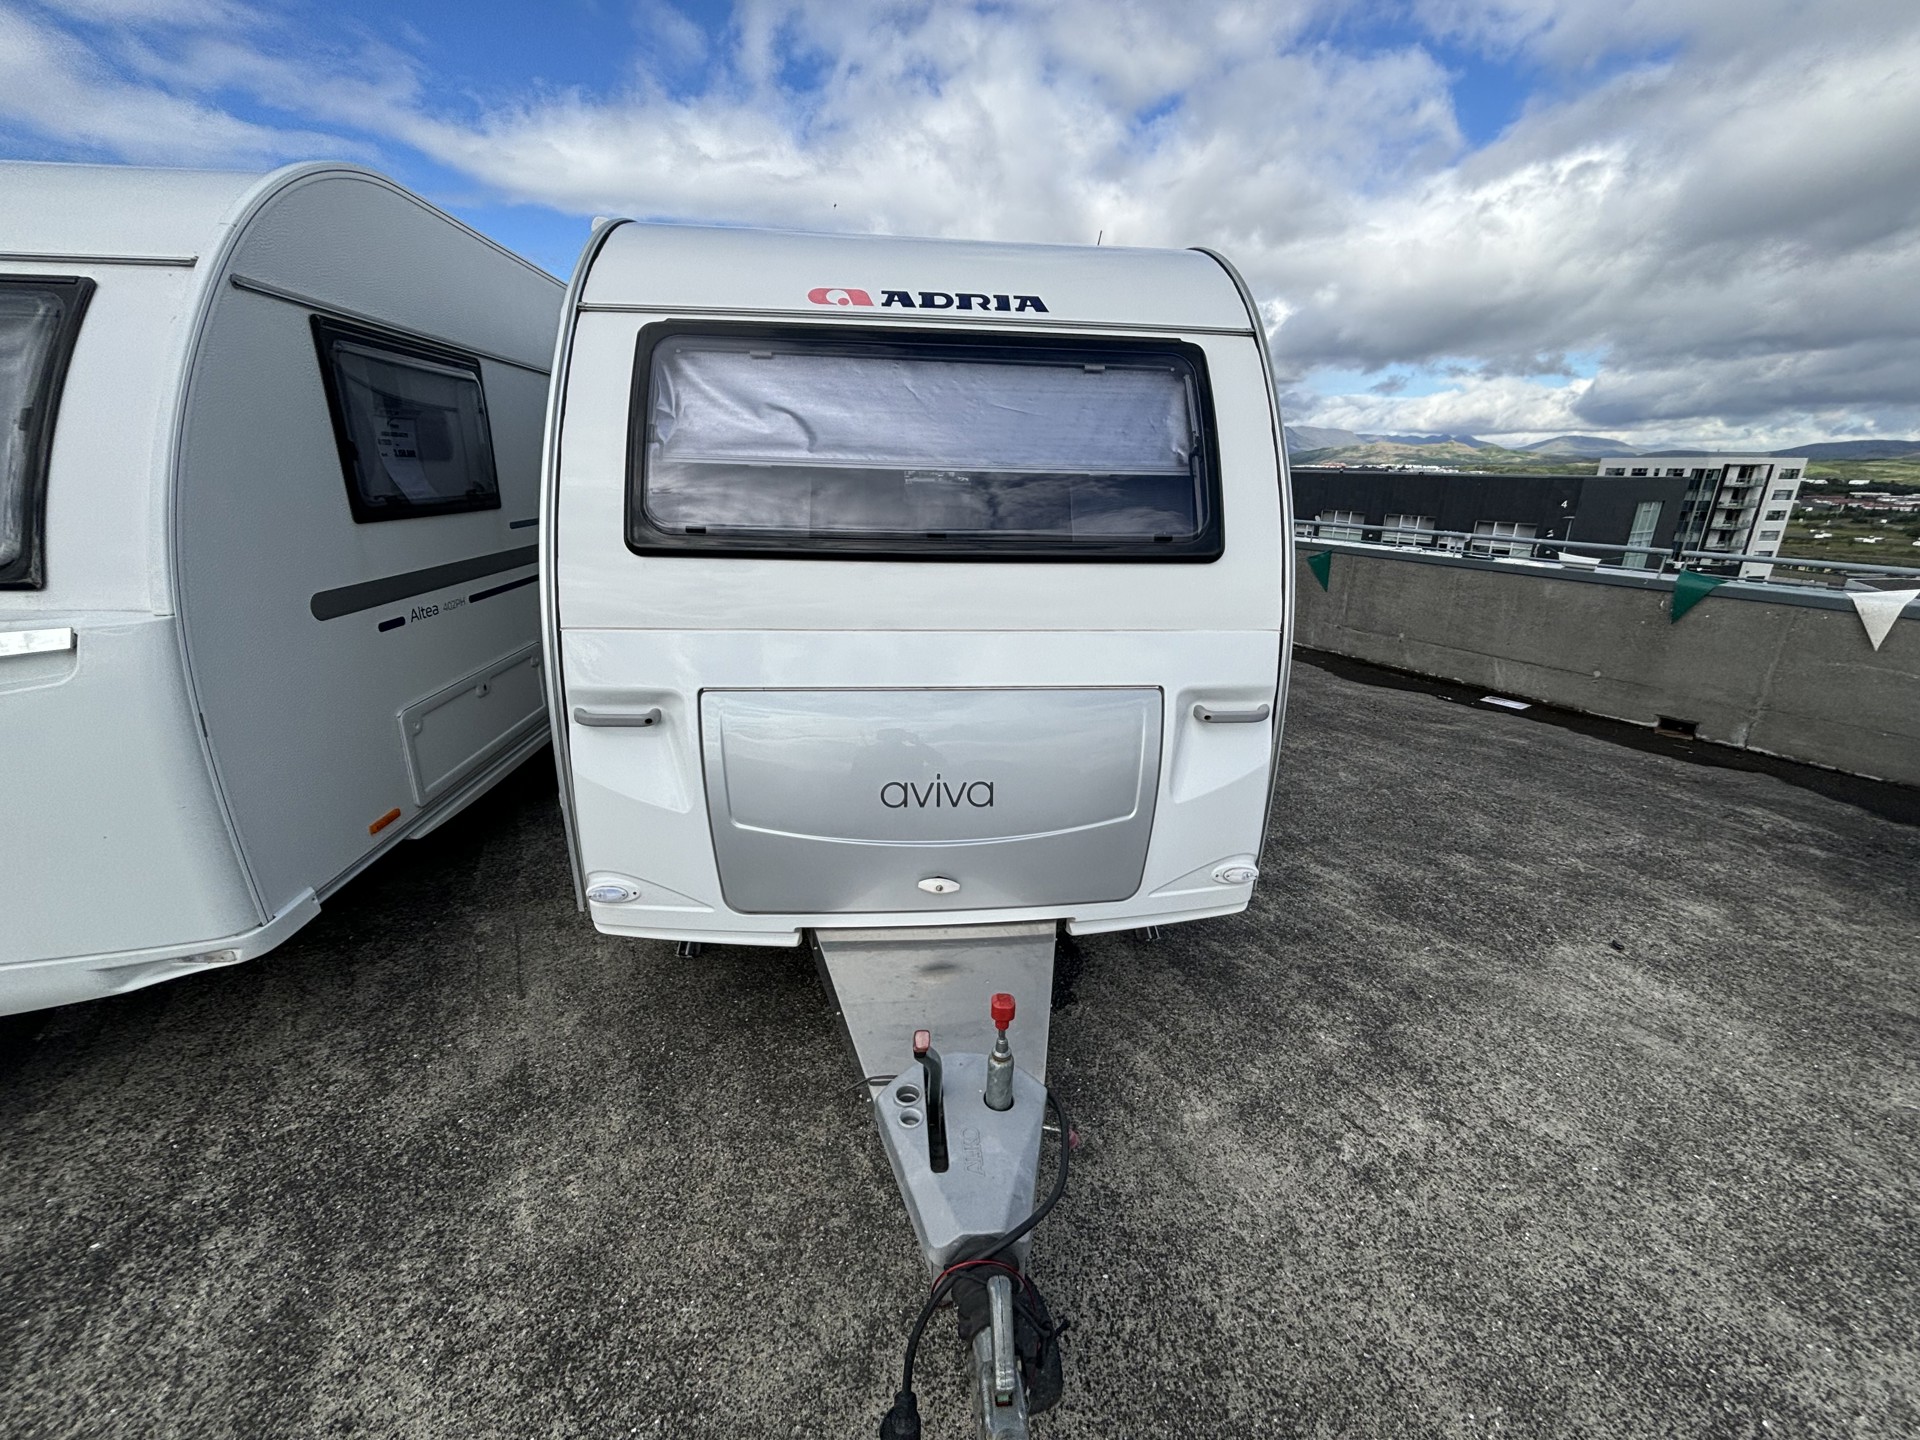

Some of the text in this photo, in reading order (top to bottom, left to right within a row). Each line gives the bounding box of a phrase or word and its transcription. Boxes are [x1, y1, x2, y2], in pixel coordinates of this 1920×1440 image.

[881, 290, 1049, 312] ADRIA
[410, 604, 440, 623] Altea
[880, 773, 994, 808] aviva
